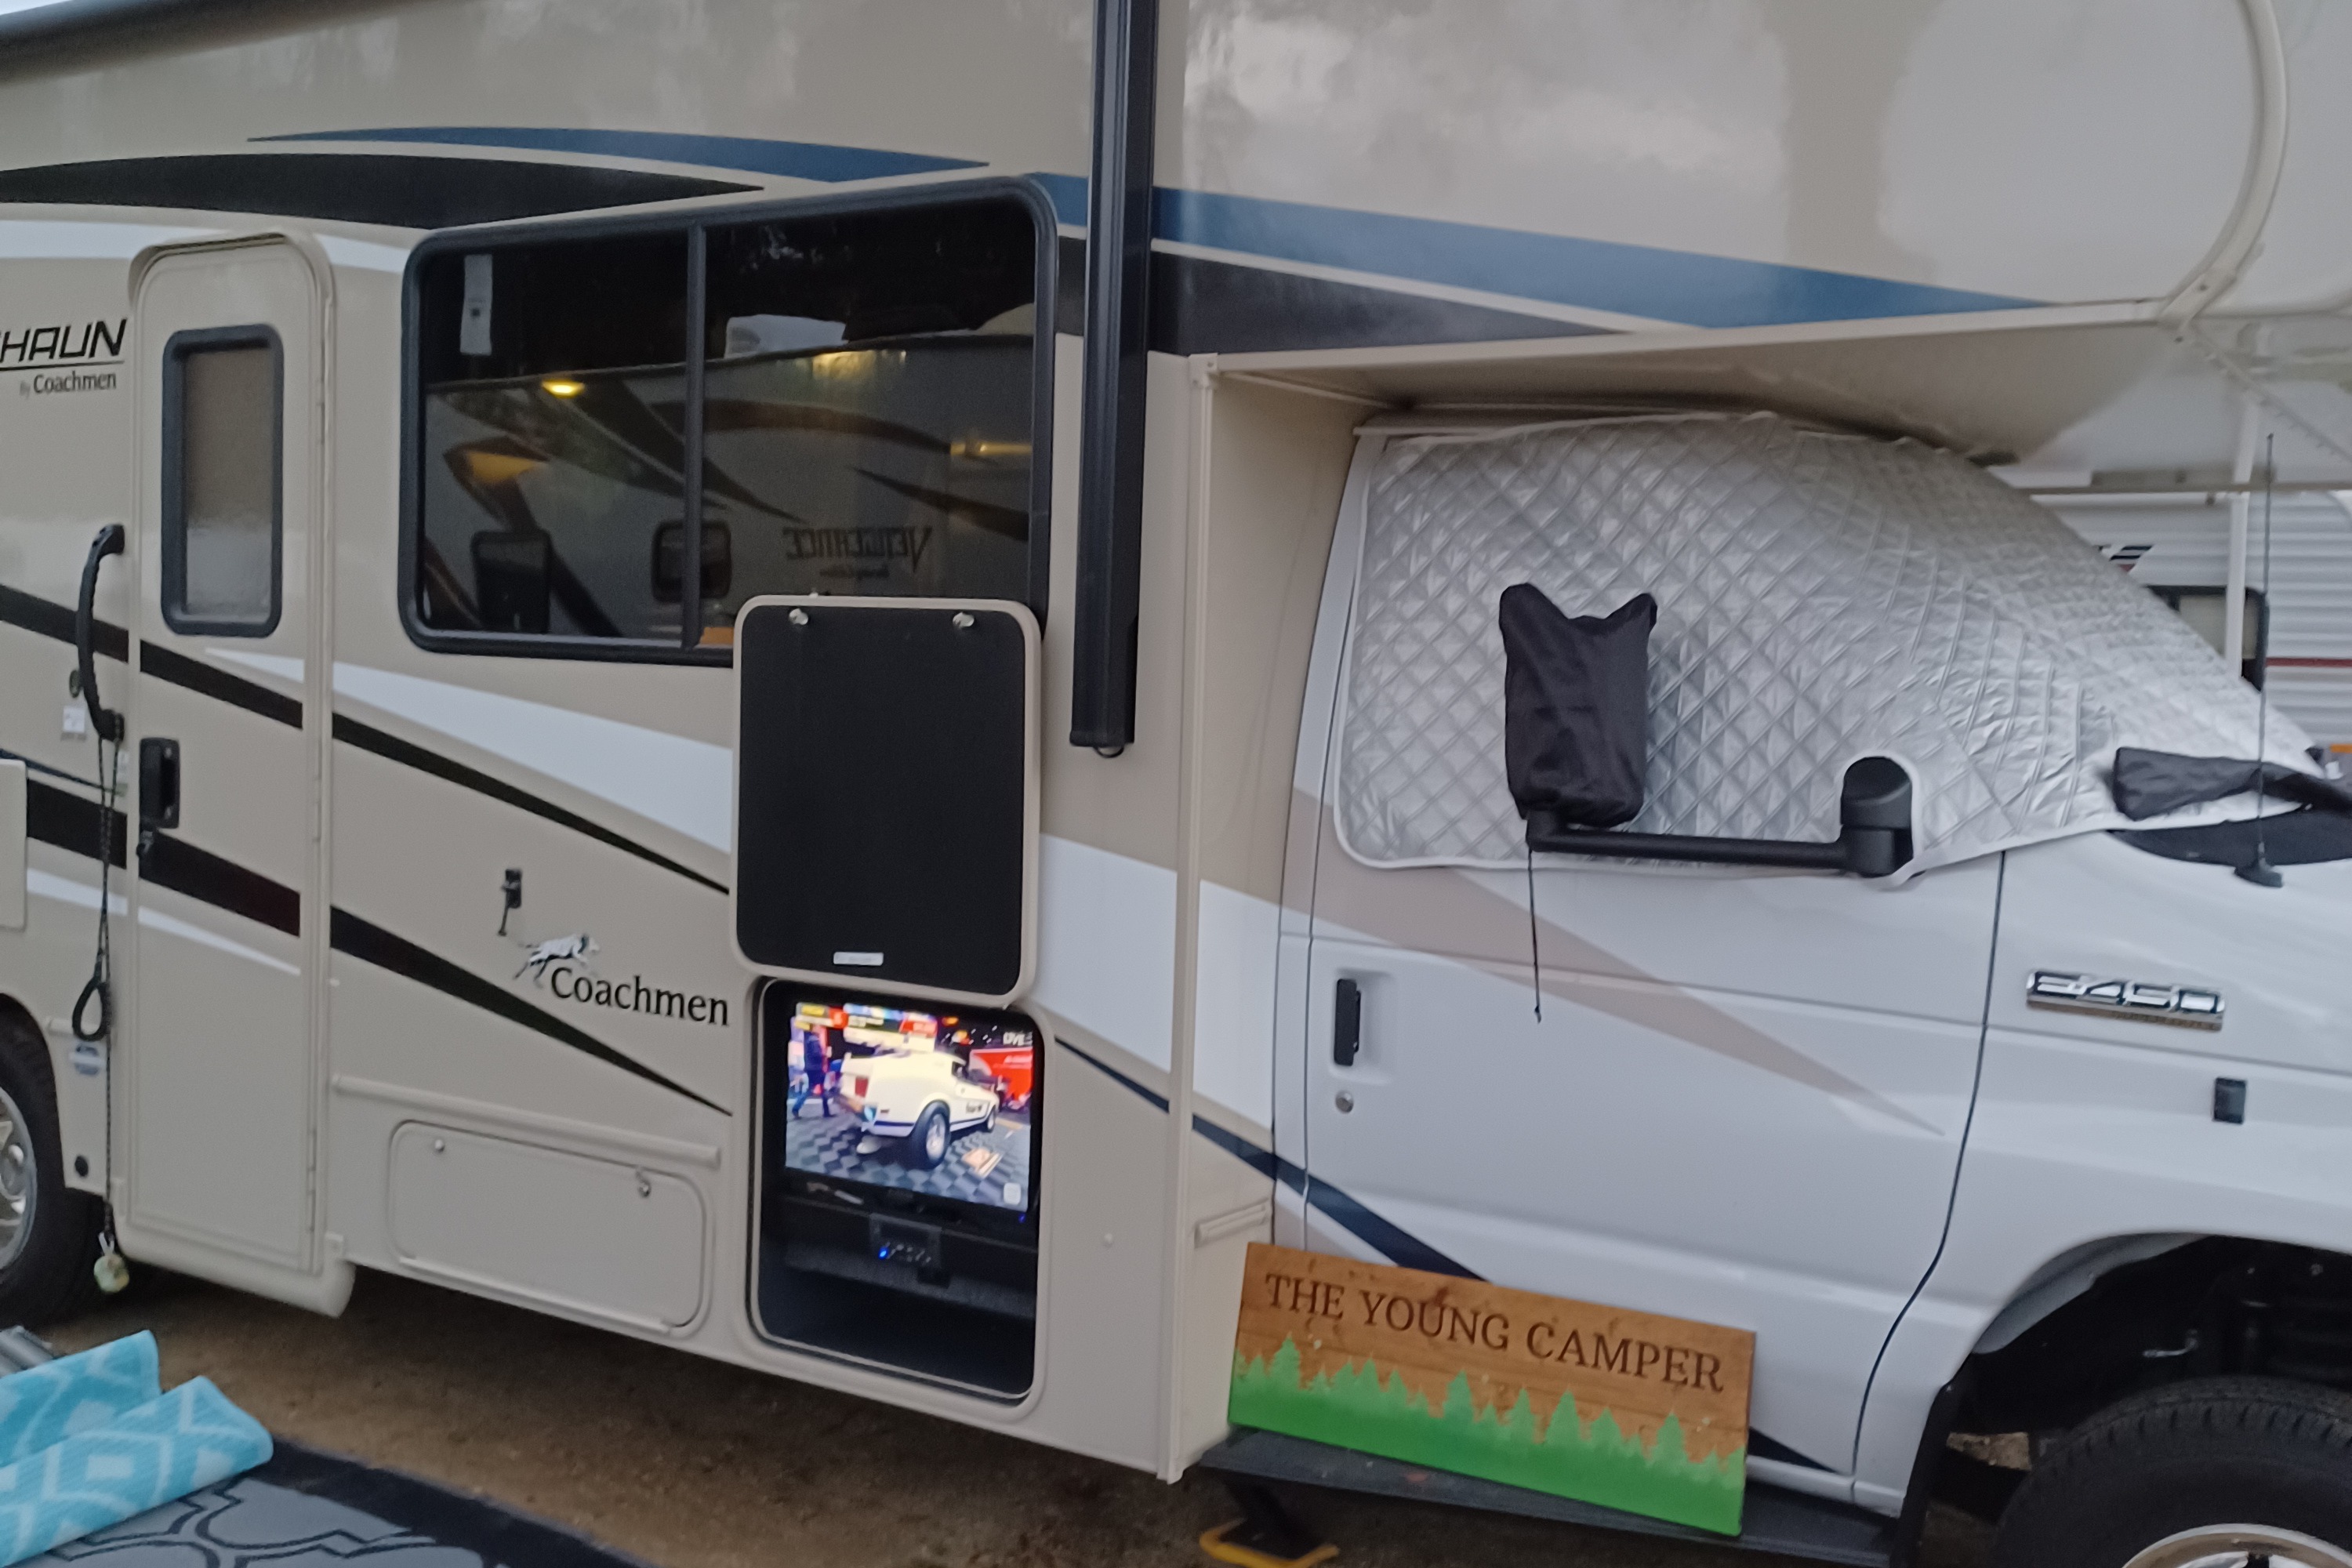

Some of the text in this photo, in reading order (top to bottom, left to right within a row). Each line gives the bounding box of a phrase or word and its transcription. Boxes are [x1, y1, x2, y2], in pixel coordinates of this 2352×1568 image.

[0, 318, 127, 362] HAUN
[33, 370, 117, 393] Coachmen
[551, 967, 729, 1026] Coachmen
[1265, 1273, 1724, 1393] THE YOUNG CAMPER
